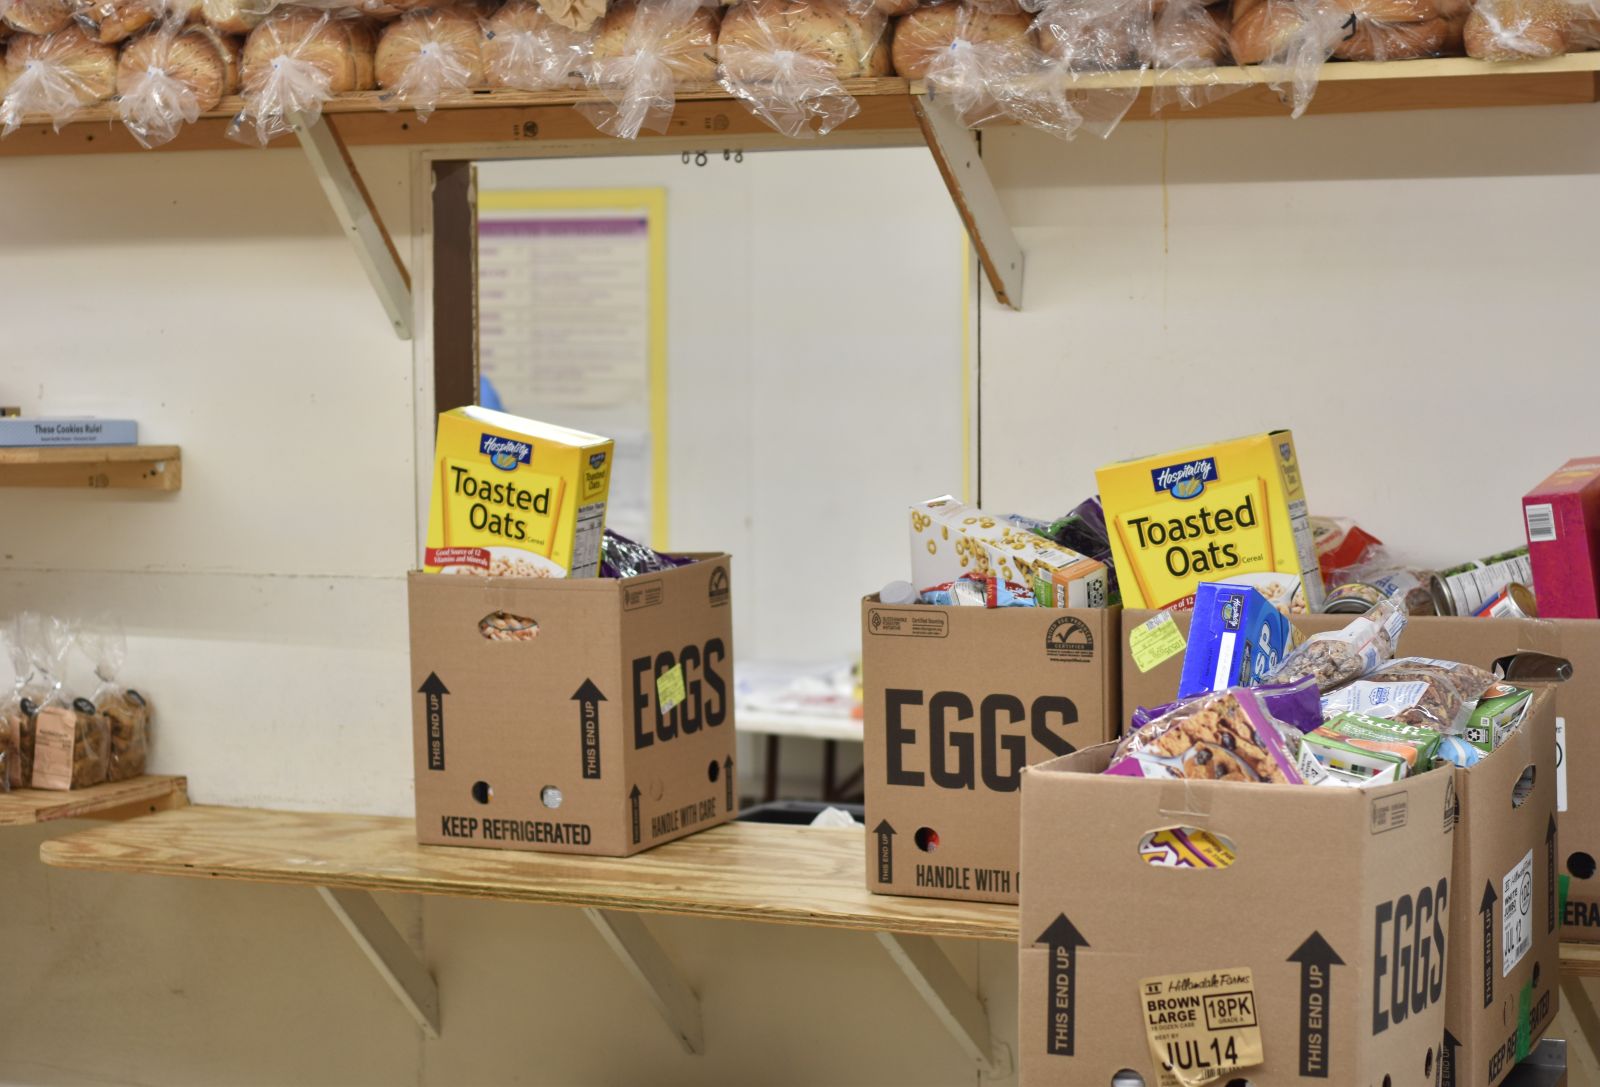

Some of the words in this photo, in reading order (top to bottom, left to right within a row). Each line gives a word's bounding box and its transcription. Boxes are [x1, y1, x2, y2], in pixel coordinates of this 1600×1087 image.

[34, 424, 55, 434] These
[56, 424, 83, 434] Cookies
[484, 437, 531, 459] Hospitality
[1157, 460, 1213, 488] Hospitality
[450, 466, 550, 514] Toasted
[469, 504, 526, 540] Oats
[1127, 495, 1256, 548] Toasted
[1165, 541, 1239, 577] Oats
[1241, 554, 1264, 565] Cereal
[1178, 599, 1185, 608] of
[1186, 596, 1194, 606] 12
[431, 695, 439, 711] UP
[586, 701, 595, 718] UP
[432, 715, 441, 736] END
[586, 720, 596, 744] END
[432, 739, 441, 767] THIS
[587, 748, 597, 775] THIS
[441, 815, 478, 839] KEEP
[483, 818, 591, 845] REFRIGERATED
[651, 810, 679, 838] HANDLE
[680, 803, 698, 828] WITH
[699, 797, 716, 821] CARE
[882, 834, 889, 847] UP
[882, 863, 890, 882] THIS
[916, 864, 970, 891] HANDLE
[975, 868, 1011, 894] WITH
[1056, 946, 1069, 969] UP
[1372, 877, 1447, 1036] EGGS
[1309, 965, 1323, 988] UP
[1056, 977, 1069, 1009] END
[1147, 996, 1200, 1012] BROWN
[1149, 1010, 1197, 1025] LARGE
[1208, 997, 1251, 1018] 18PK
[1308, 999, 1322, 1031] END
[1055, 1012, 1069, 1050] THIS
[1307, 1033, 1321, 1072] THIS
[1488, 1043, 1506, 1086] KEEP
